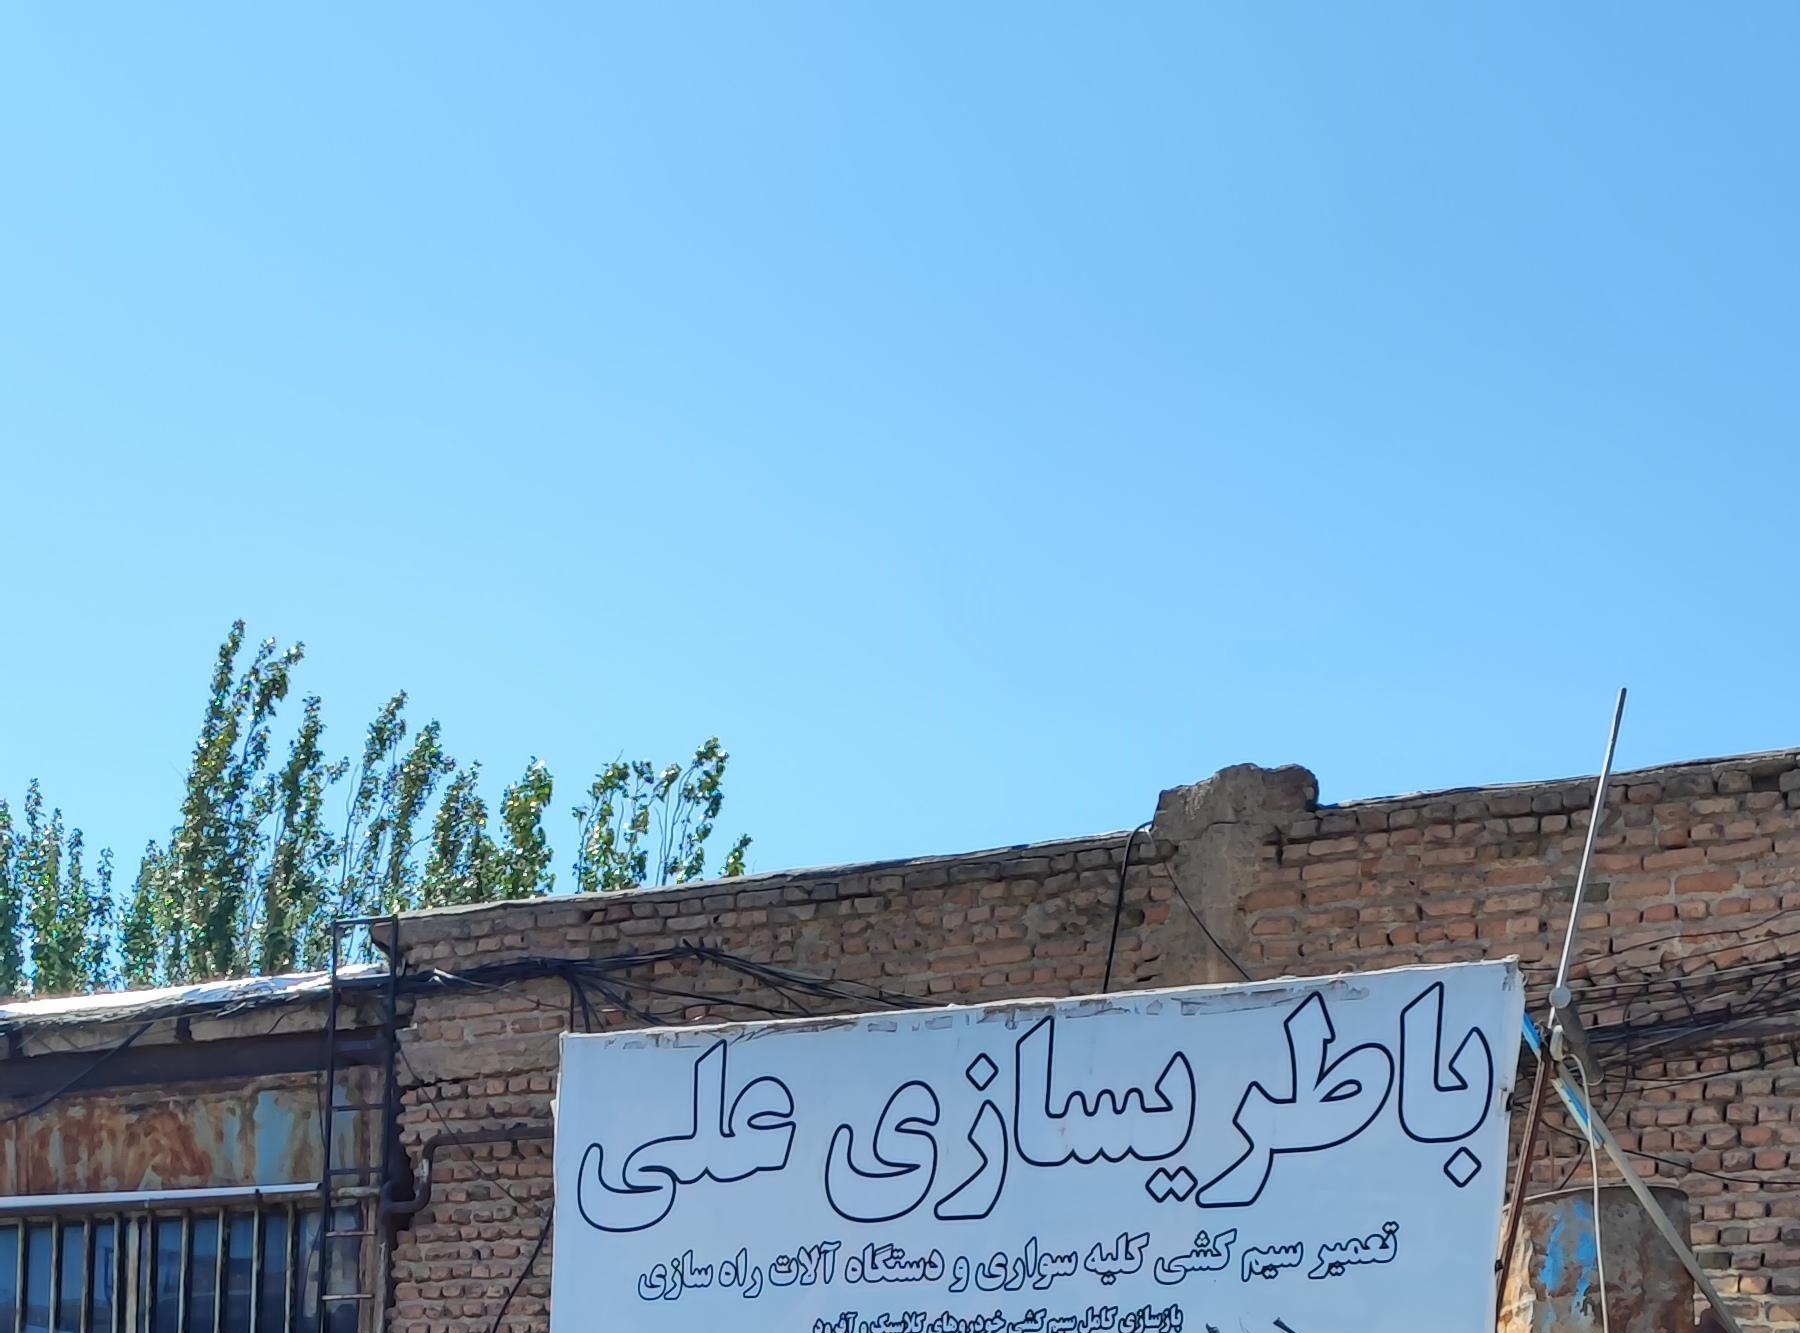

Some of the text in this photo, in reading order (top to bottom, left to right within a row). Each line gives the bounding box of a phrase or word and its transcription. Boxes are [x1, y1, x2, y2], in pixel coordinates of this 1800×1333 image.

[576, 980, 1494, 1233] باطریسازی علی
[637, 1220, 1400, 1301] تعمیر سیم کشی کلیه سواری و دستگاه آلات راه سازی
